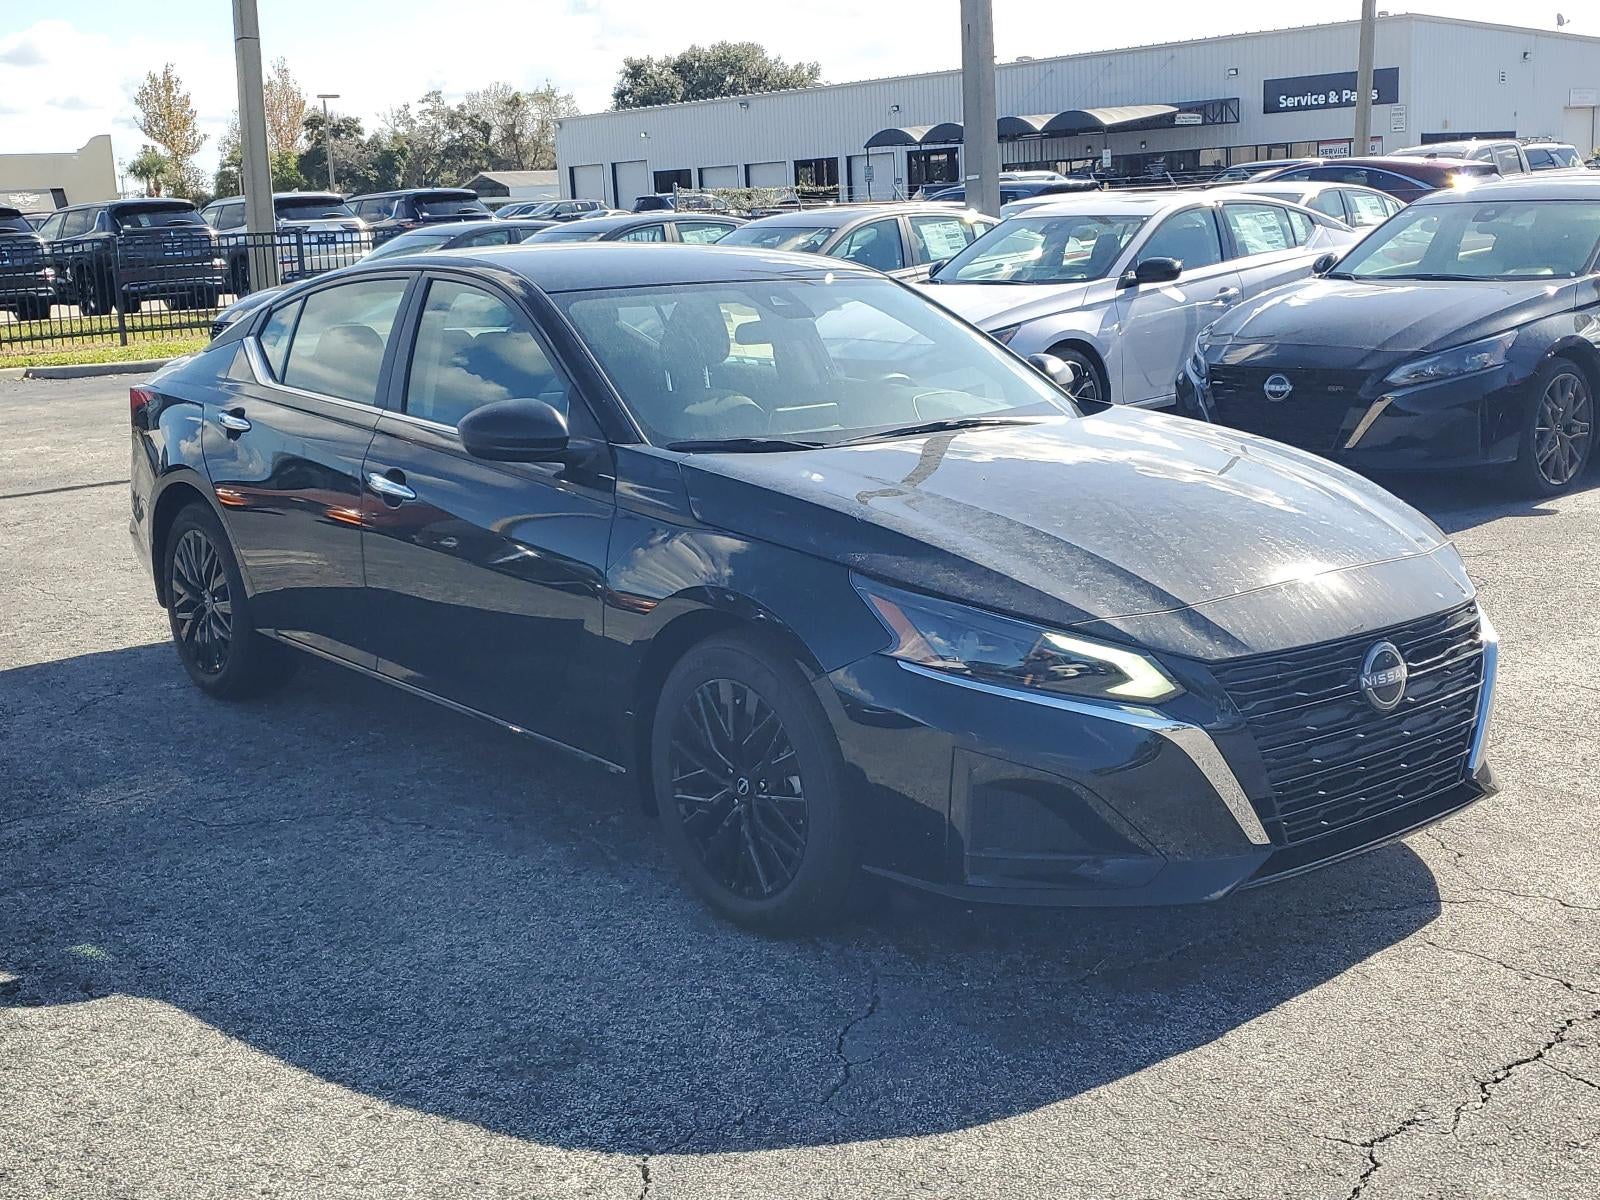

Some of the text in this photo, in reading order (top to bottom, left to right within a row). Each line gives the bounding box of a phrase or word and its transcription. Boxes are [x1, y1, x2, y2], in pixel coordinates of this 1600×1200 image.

[1279, 89, 1379, 108] Service & Pas
[1320, 147, 1348, 156] SERVICE
